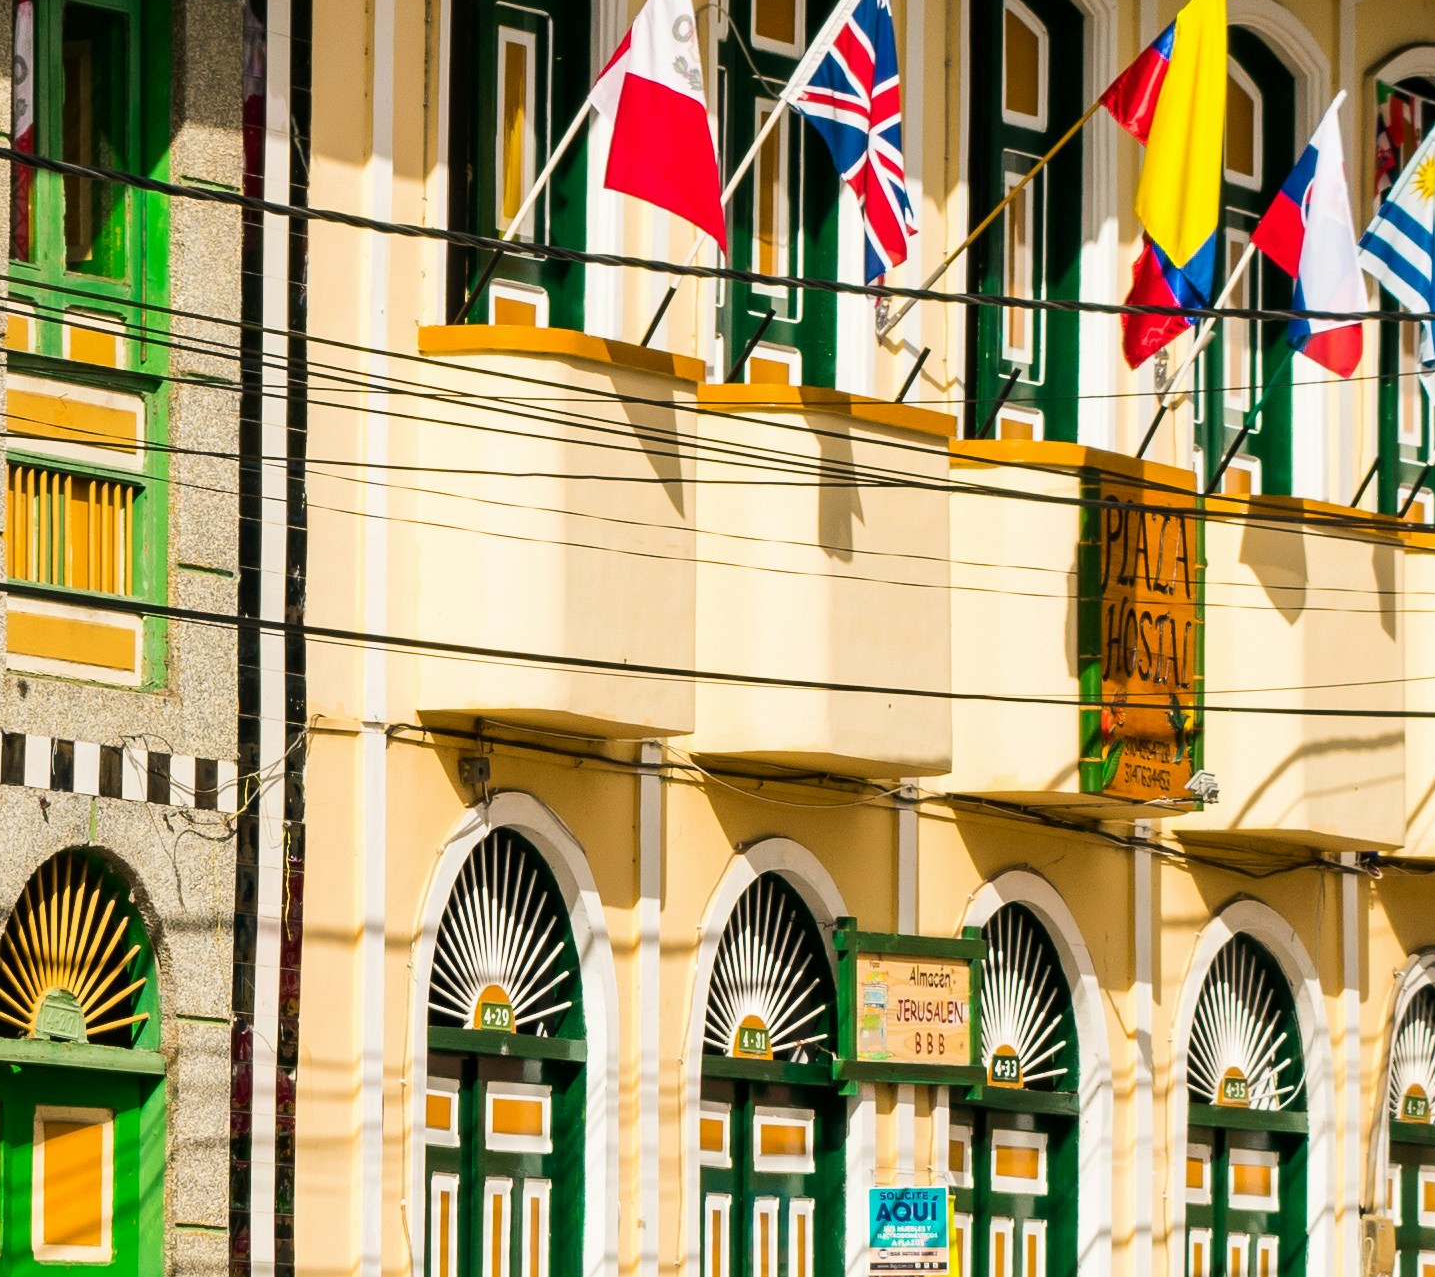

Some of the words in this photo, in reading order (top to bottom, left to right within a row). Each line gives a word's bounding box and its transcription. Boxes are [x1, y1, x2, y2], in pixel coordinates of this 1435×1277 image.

[1101, 495, 1192, 600] PLAZA
[1102, 596, 1193, 689] HOSTAL
[909, 965, 952, 989] Almacén
[896, 998, 964, 1024] JERUSALEN
[876, 1195, 939, 1222] AQUÍ
[879, 1191, 929, 1201] SOLICITE
